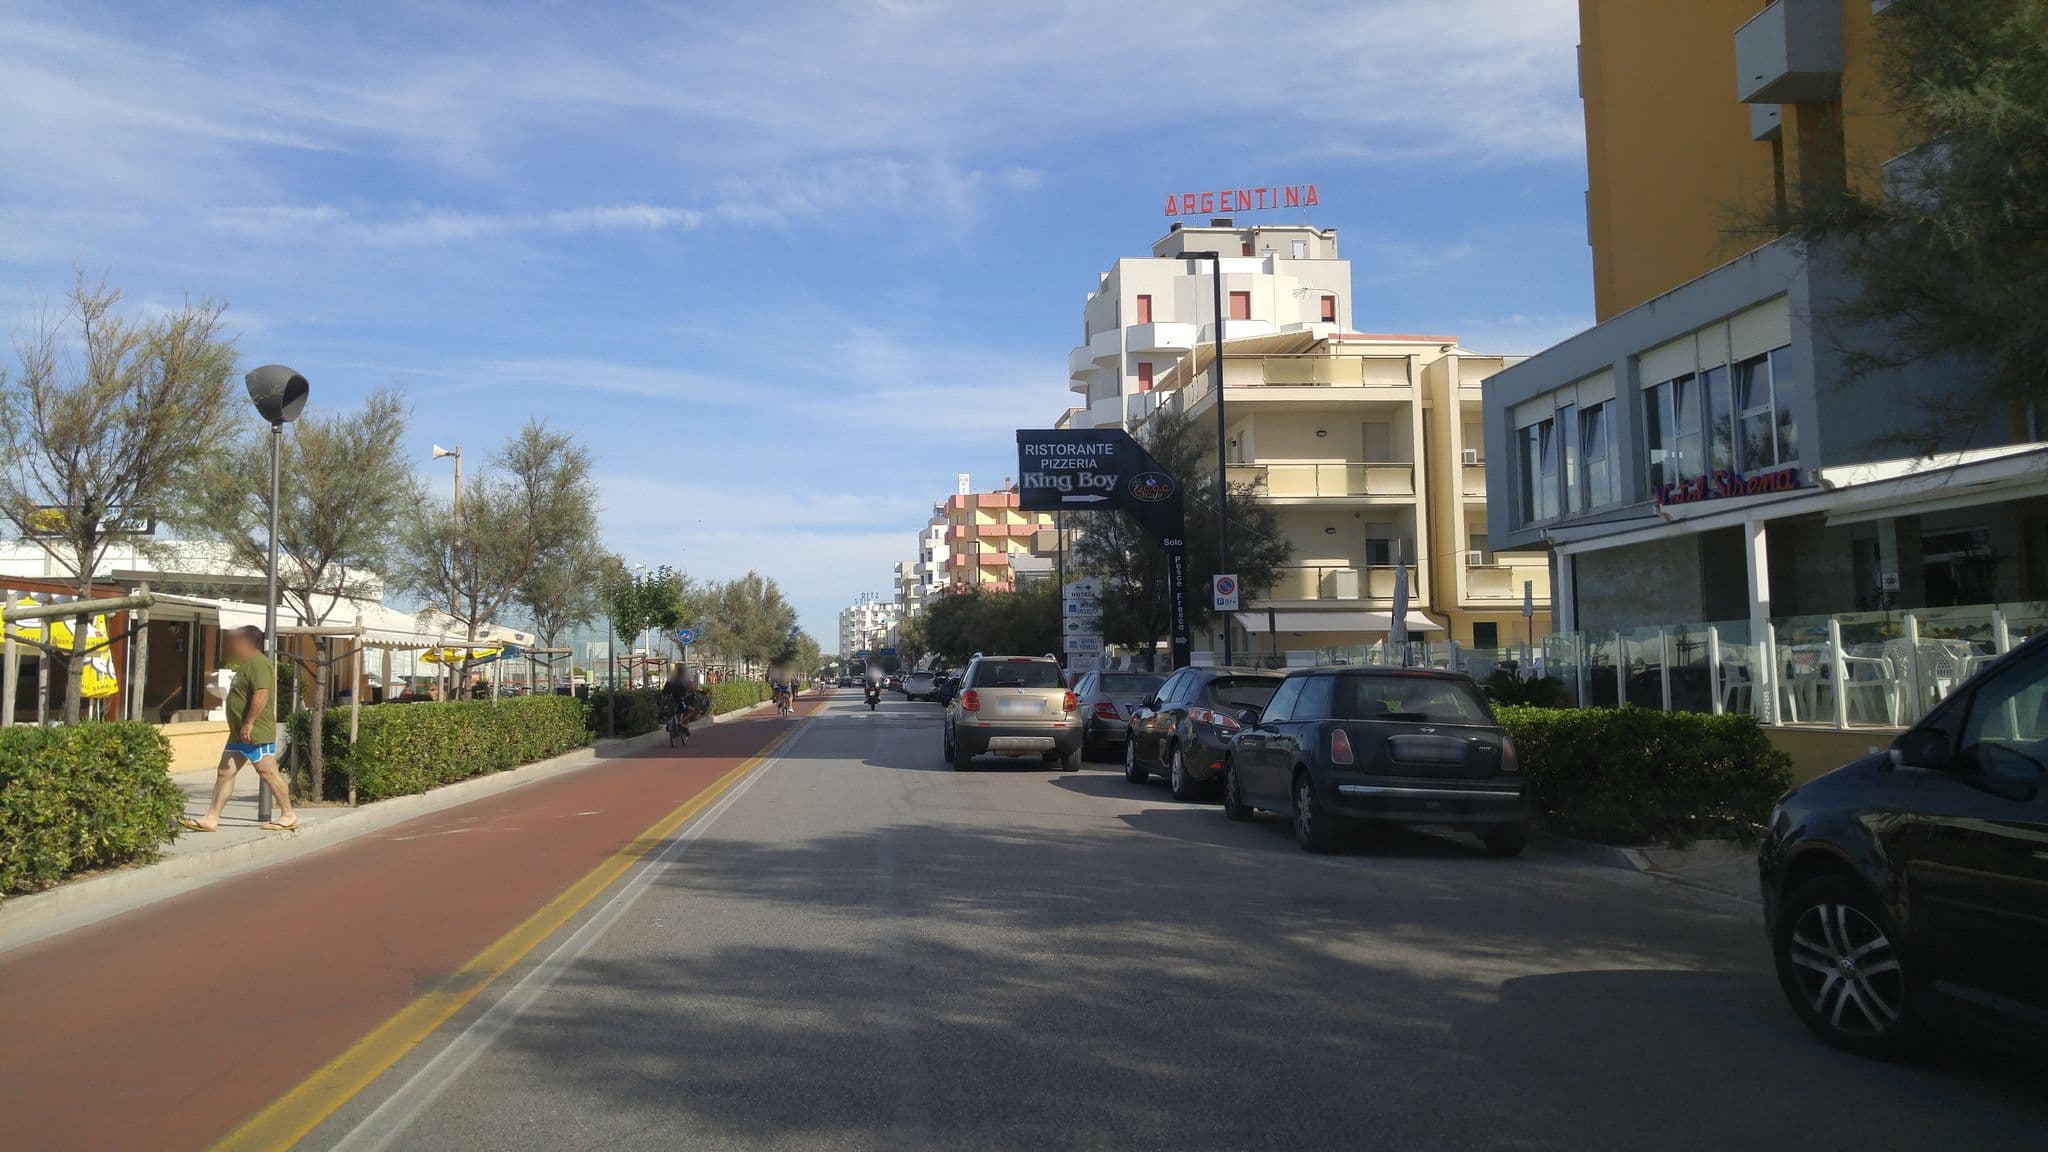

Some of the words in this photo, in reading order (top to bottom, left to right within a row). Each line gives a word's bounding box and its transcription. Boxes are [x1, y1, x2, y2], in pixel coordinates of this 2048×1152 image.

[1165, 184, 1319, 216] ARGENTINA
[1025, 443, 1114, 456] RISTORANTE
[1041, 458, 1098, 469] PIZZERIA
[1023, 472, 1073, 492] King
[1077, 472, 1119, 491] Boy
[1712, 468, 1799, 497] Sirena
[1163, 538, 1183, 546] Solo
[1175, 555, 1183, 587] Pesce
[1176, 593, 1184, 631] Fresco
